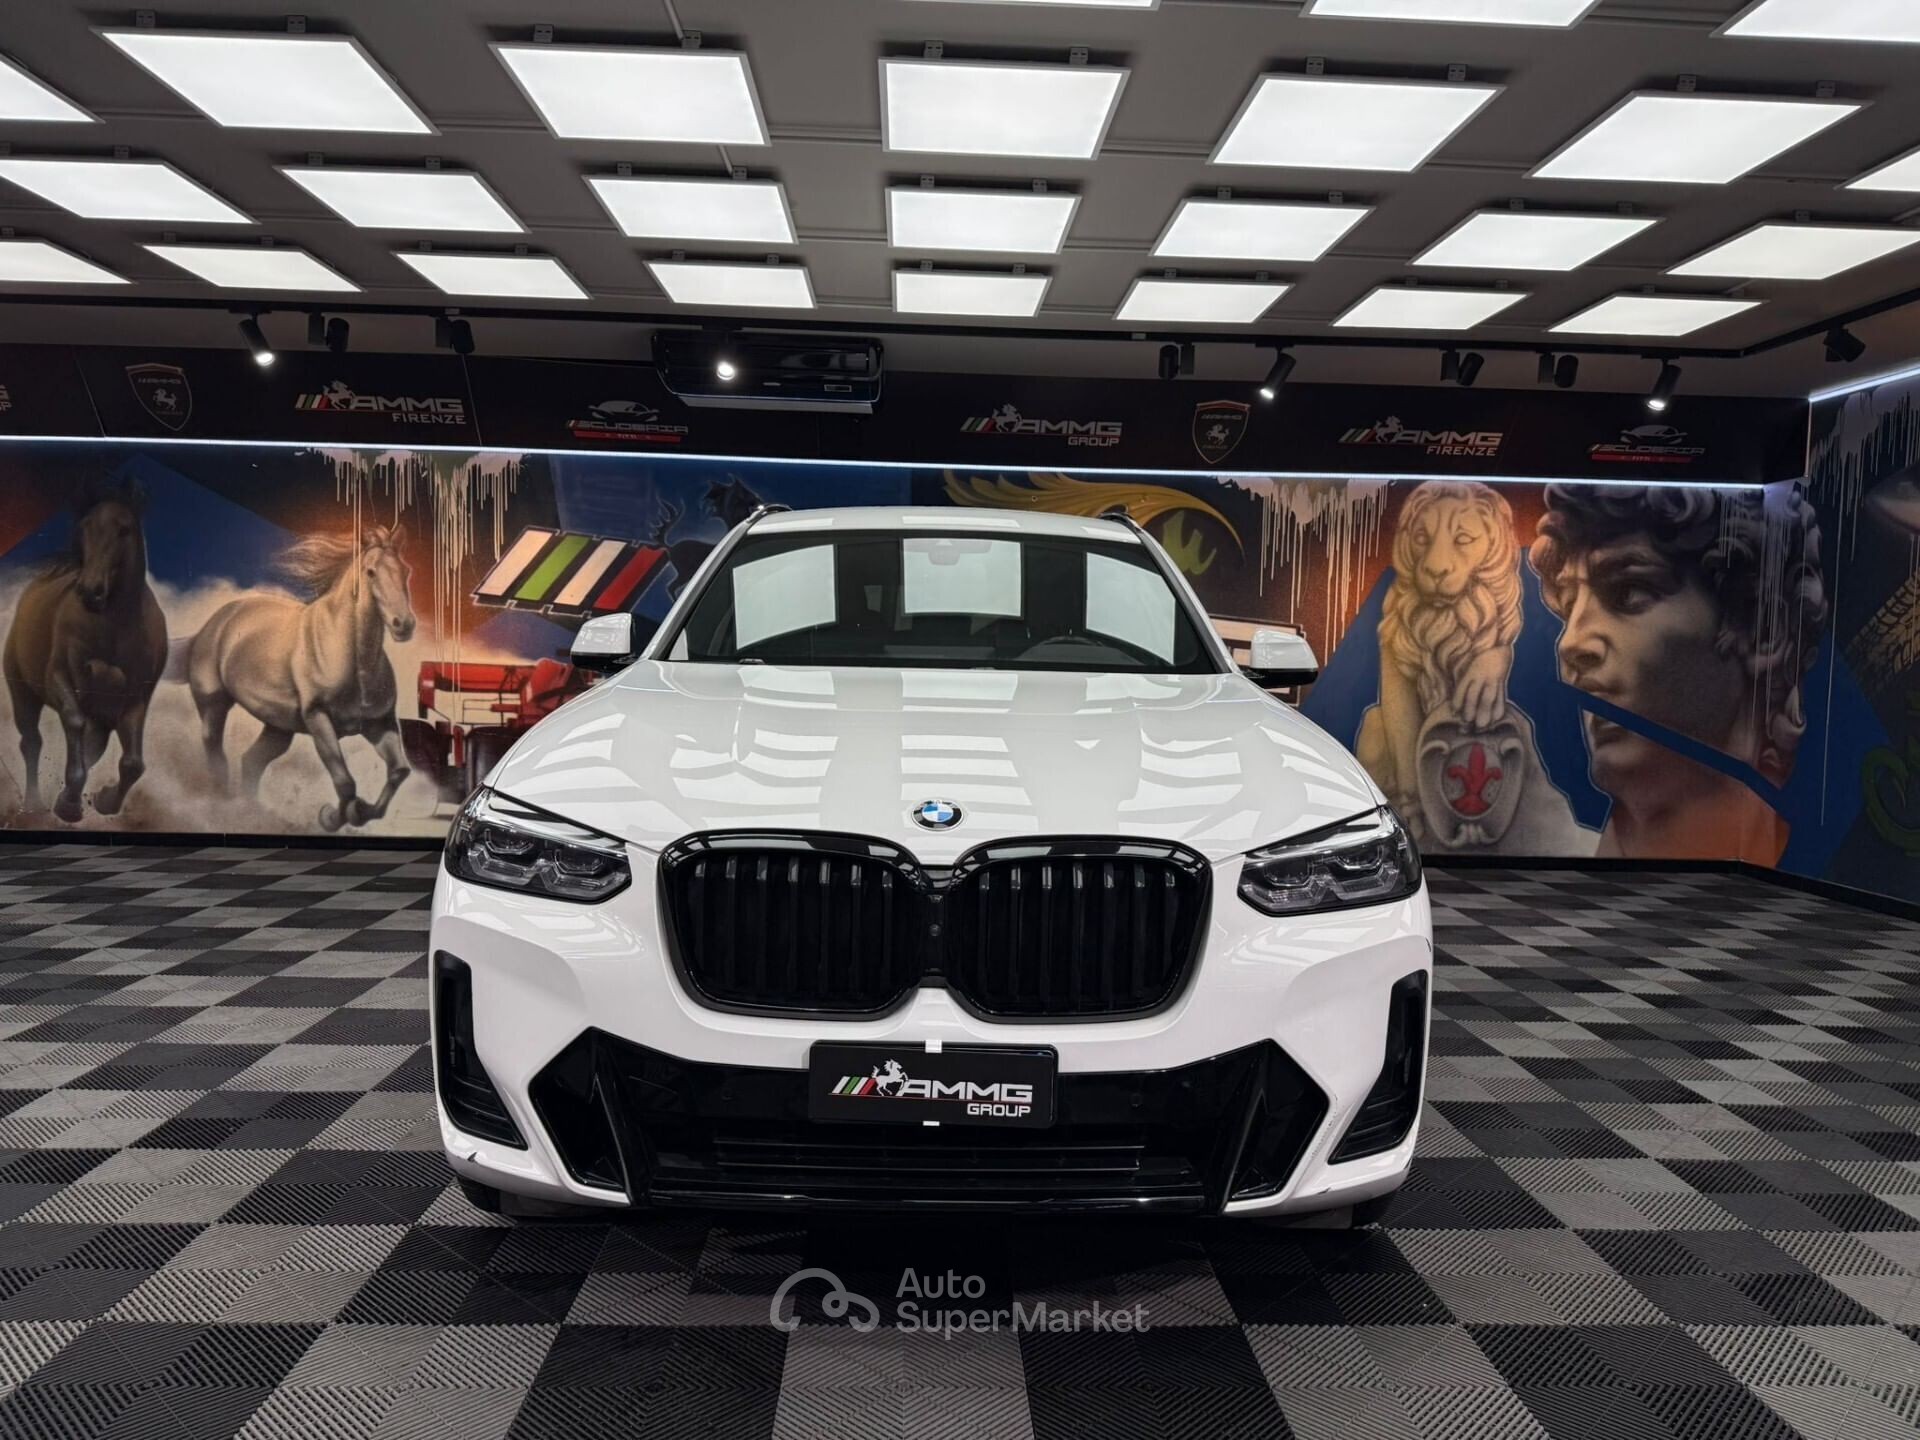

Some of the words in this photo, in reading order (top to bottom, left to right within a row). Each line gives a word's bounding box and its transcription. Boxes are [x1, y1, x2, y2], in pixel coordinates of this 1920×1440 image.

[349, 395, 464, 413] AMMG
[392, 412, 467, 424] FIRENZE
[1012, 419, 1123, 436] AMMG
[1067, 436, 1120, 447] GROUP
[1391, 430, 1504, 446] AMMG
[1426, 445, 1498, 456] FIRENZE
[896, 1079, 1033, 1103] AMMG
[967, 1103, 1031, 1117] GROUP
